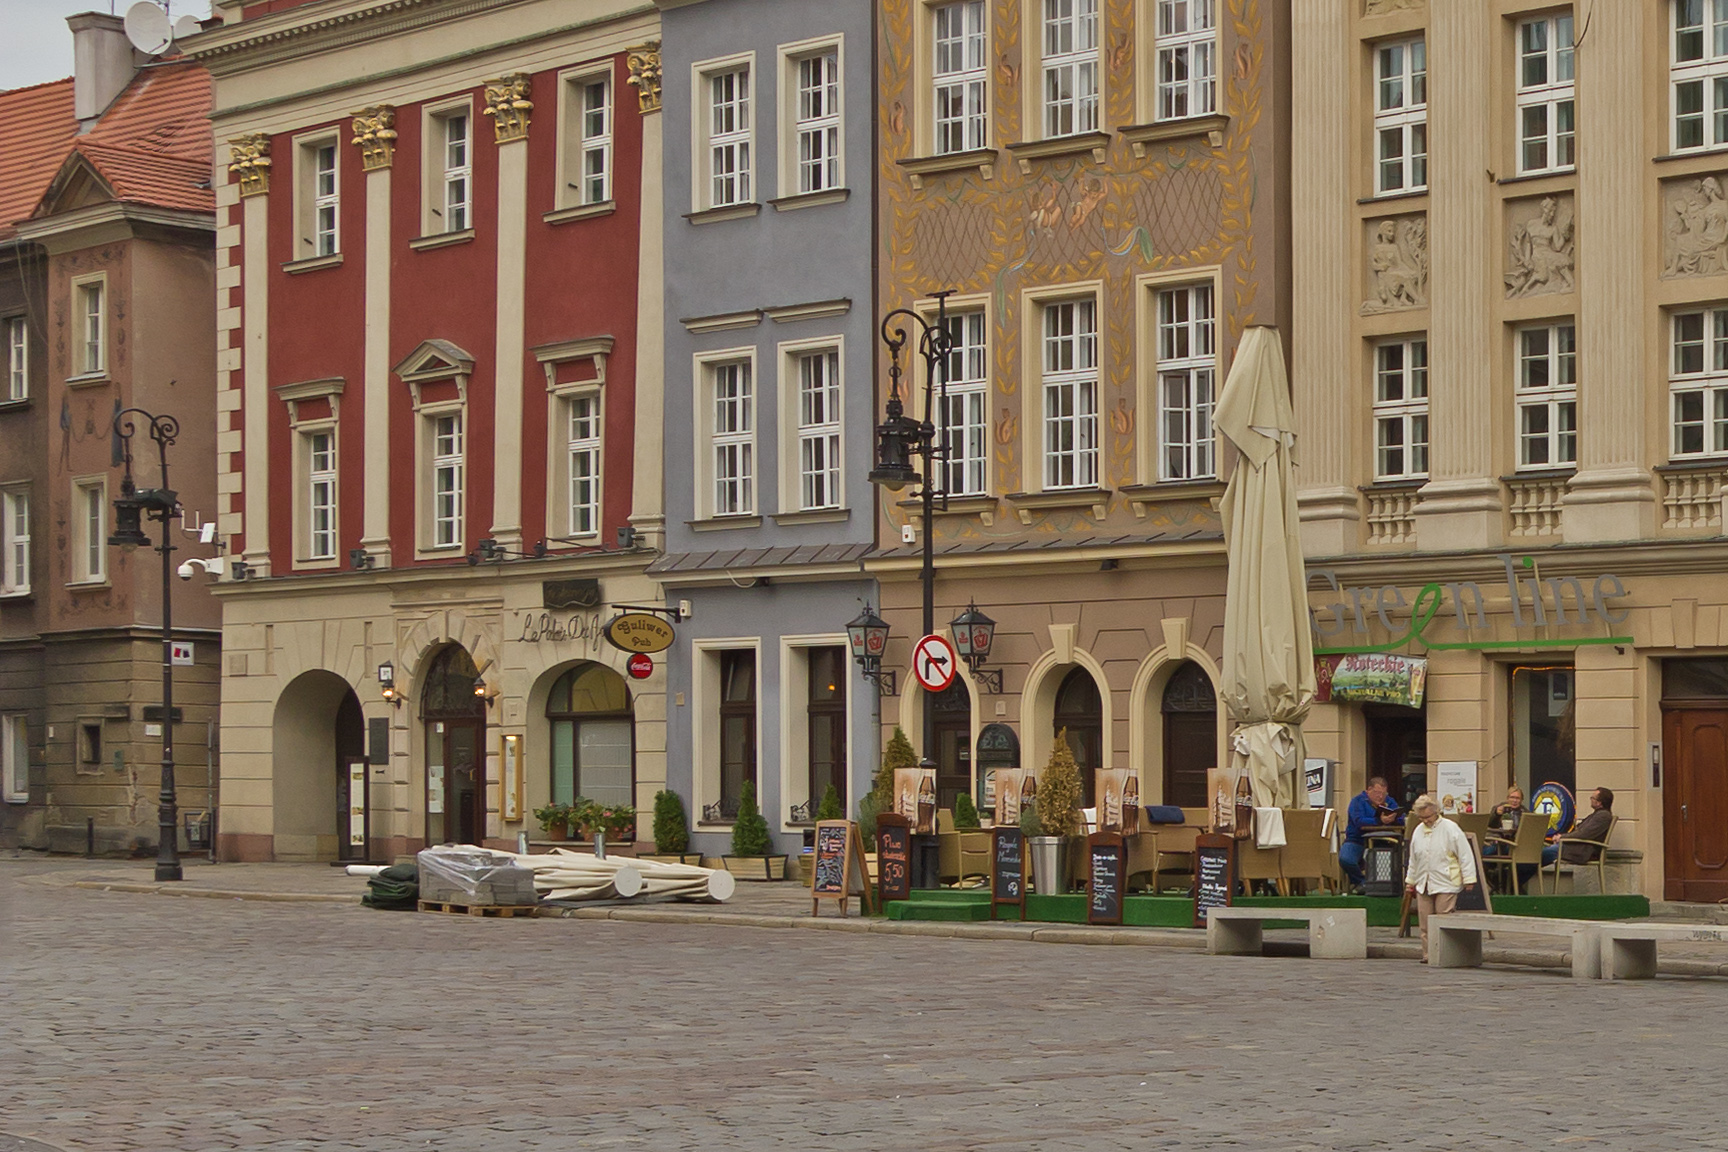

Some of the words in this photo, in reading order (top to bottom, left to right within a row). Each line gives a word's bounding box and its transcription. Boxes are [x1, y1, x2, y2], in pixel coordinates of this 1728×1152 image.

[1307, 570, 1491, 646] Green
[1497, 554, 1630, 628] line
[617, 619, 669, 638] Guliwer
[631, 636, 652, 647] Pub
